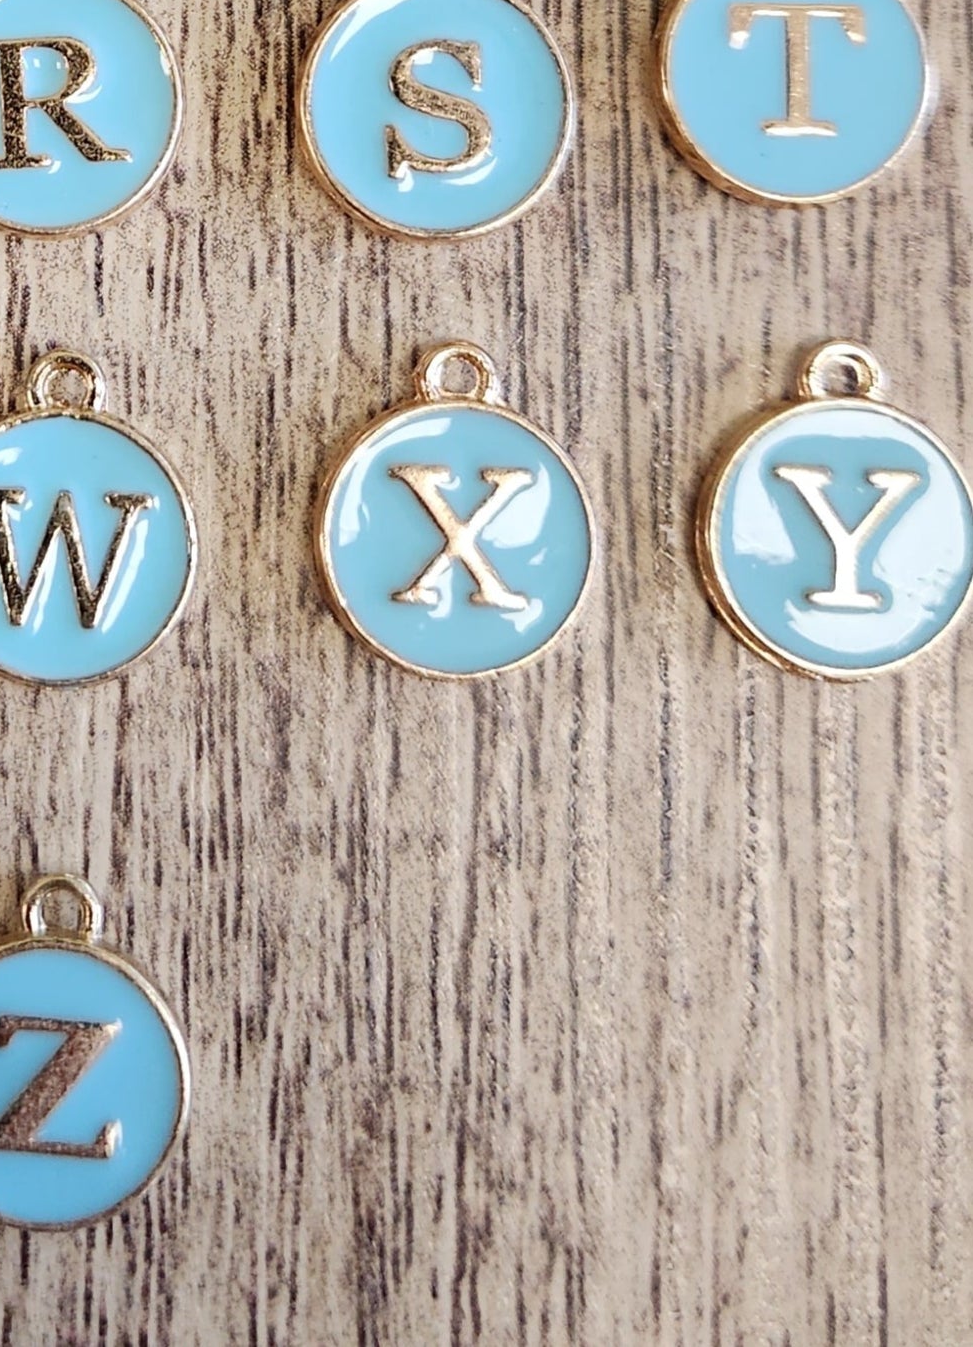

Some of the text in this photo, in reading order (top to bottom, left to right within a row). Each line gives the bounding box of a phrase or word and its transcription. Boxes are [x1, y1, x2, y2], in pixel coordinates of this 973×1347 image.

[385, 39, 490, 182] S
[728, 3, 865, 138] T
[386, 464, 537, 613] X
[771, 465, 923, 611] Y
